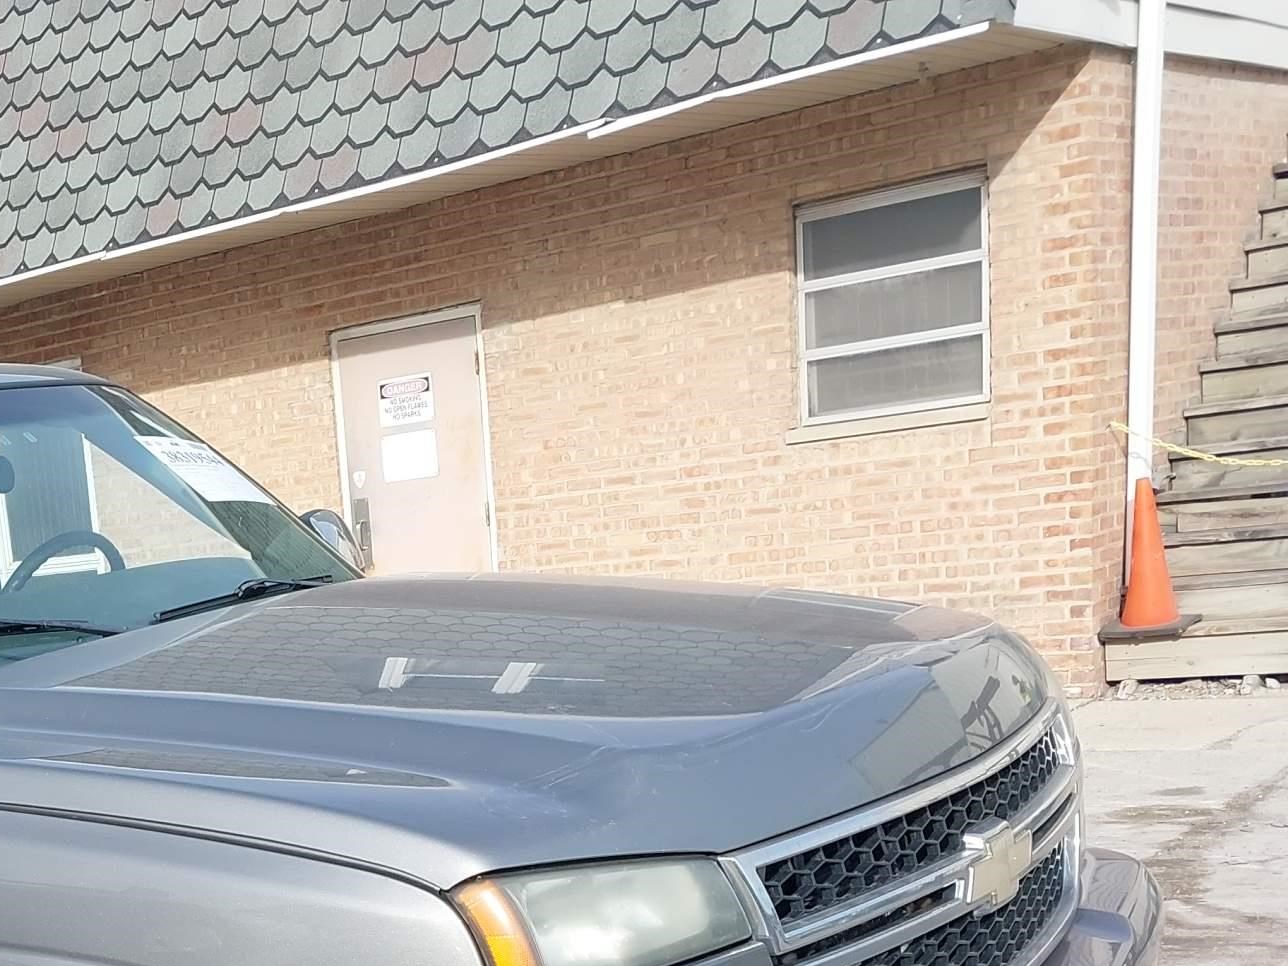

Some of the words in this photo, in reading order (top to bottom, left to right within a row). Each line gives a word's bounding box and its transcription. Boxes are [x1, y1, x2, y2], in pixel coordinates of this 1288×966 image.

[386, 381, 423, 396] DANGER
[398, 394, 422, 404] SMOKING
[384, 406, 393, 414] NO
[407, 400, 428, 410] FLAMES
[401, 410, 421, 419] SPARKS
